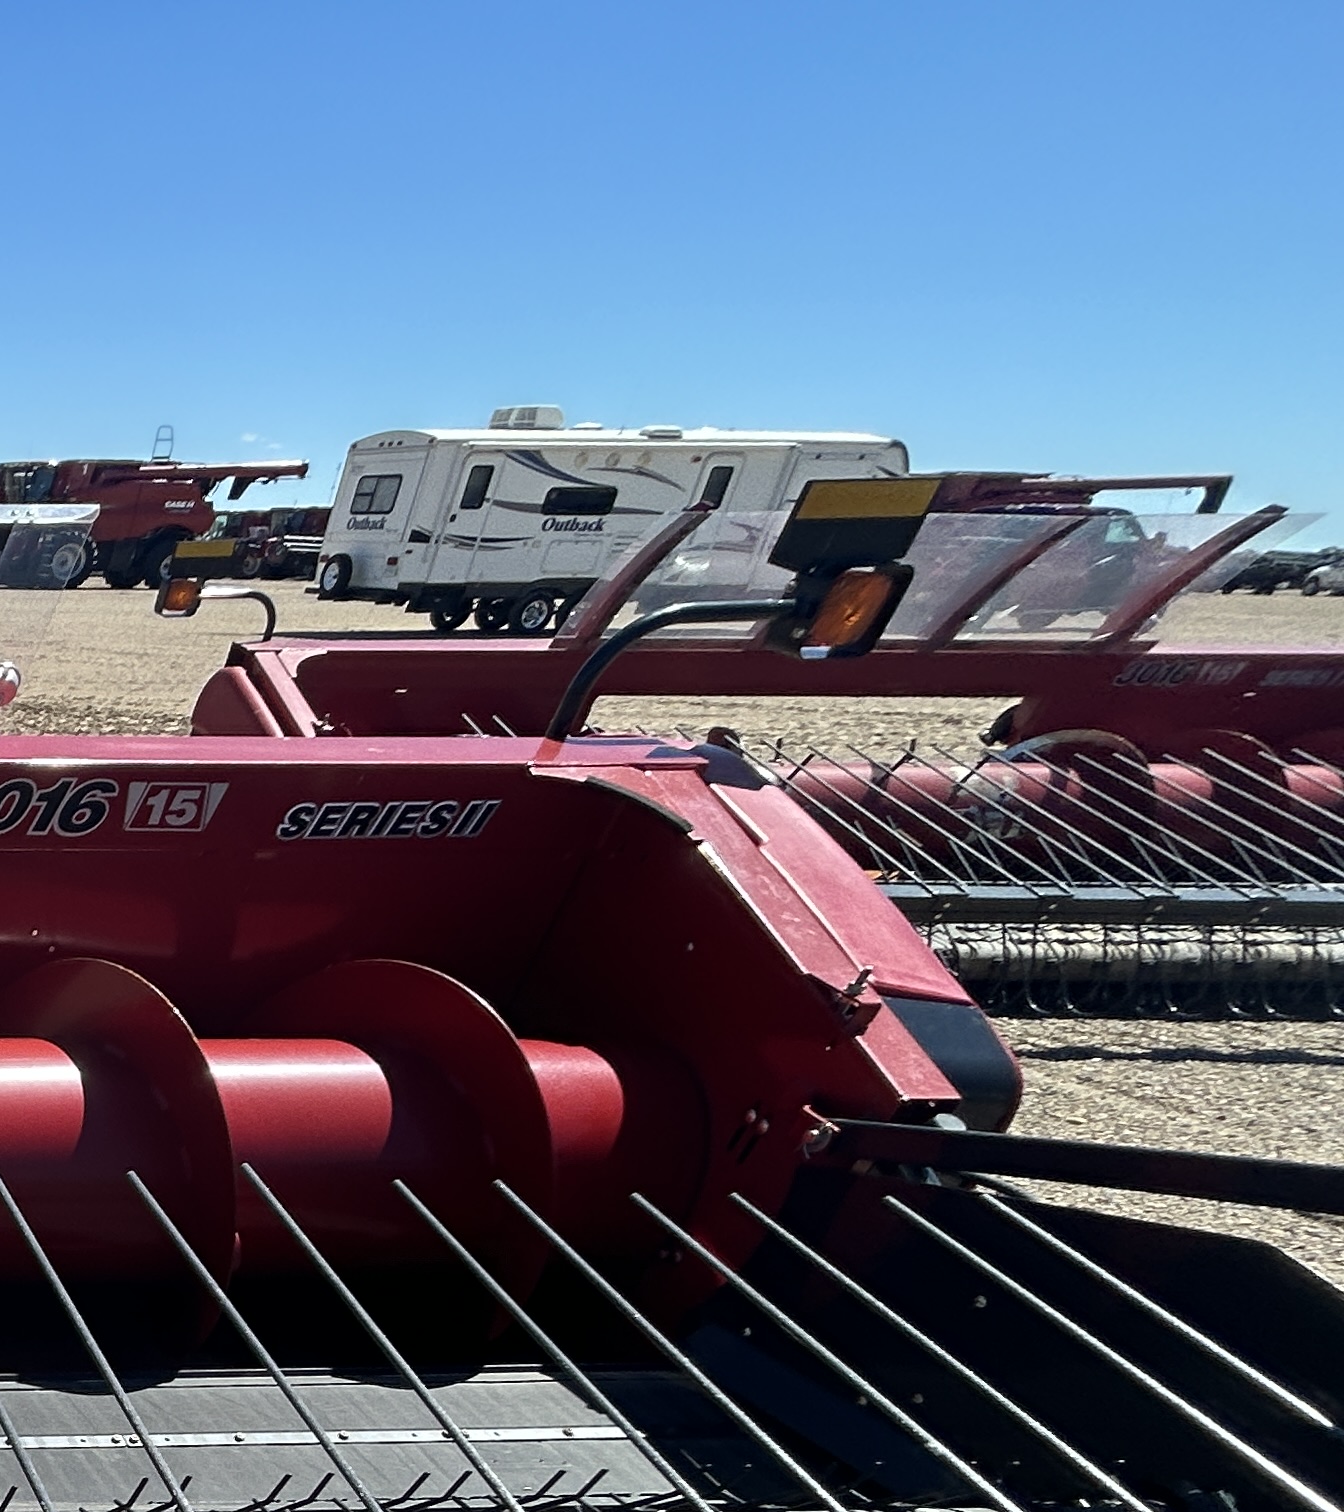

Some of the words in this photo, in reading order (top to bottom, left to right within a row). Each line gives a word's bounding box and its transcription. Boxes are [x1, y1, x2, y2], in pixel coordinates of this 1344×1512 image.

[347, 516, 388, 531] Outback
[541, 517, 607, 532] Outback
[145, 790, 202, 826] 15
